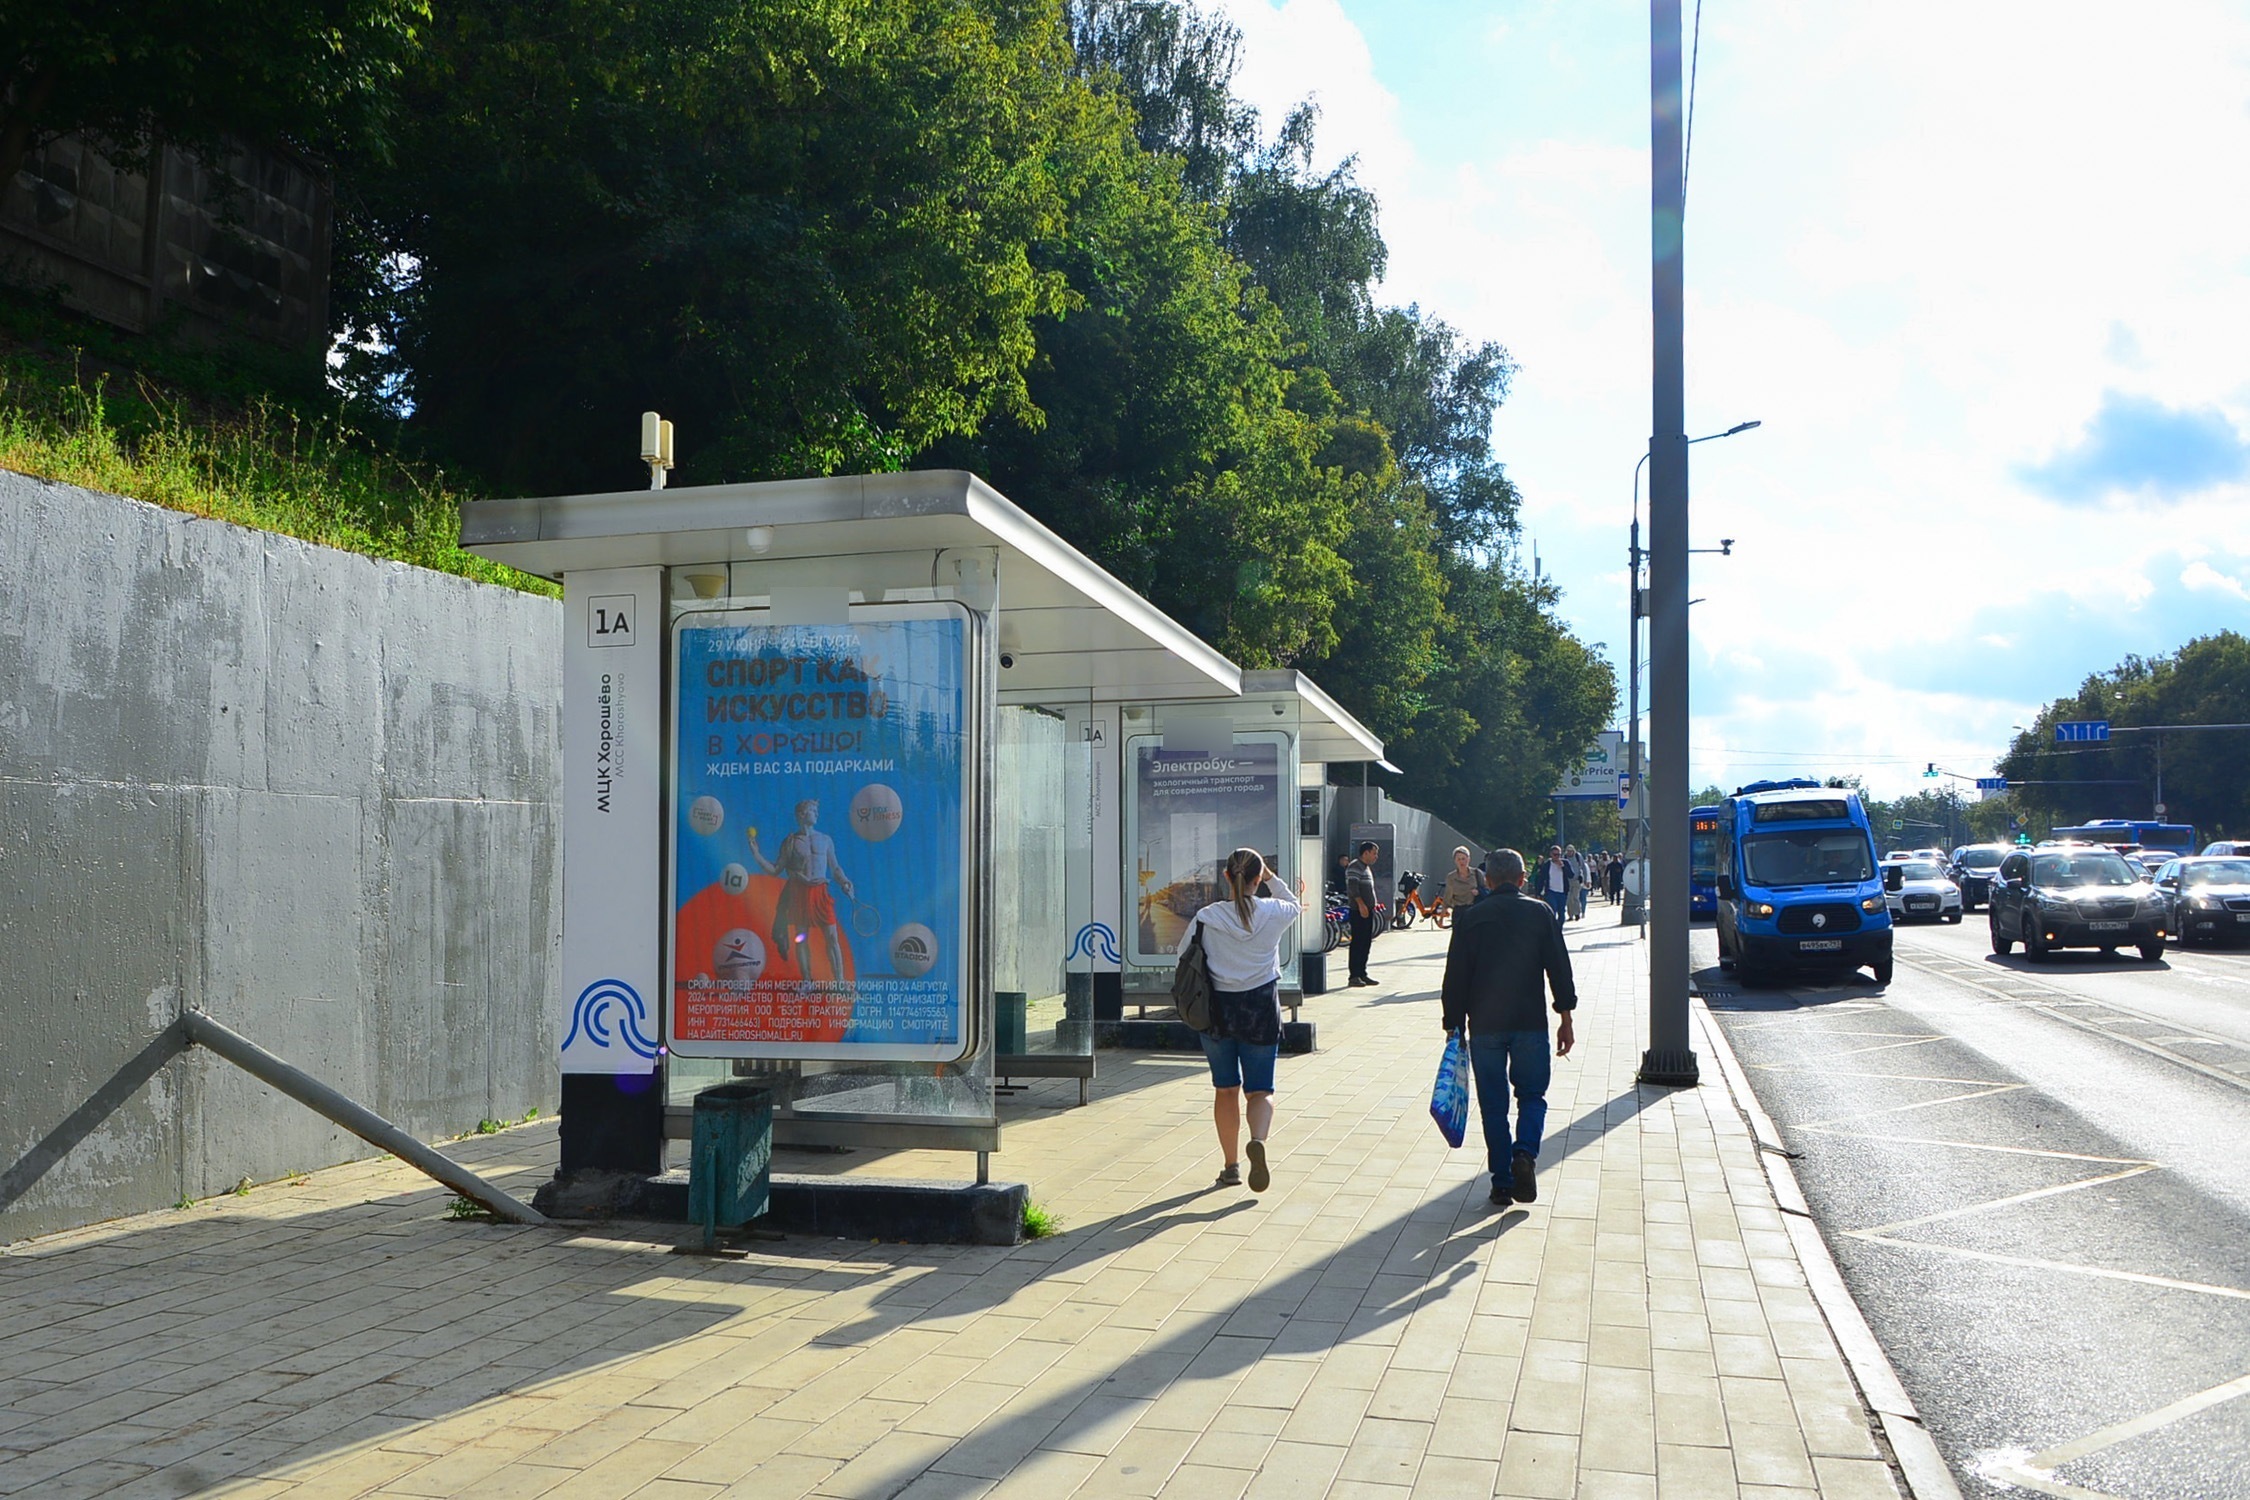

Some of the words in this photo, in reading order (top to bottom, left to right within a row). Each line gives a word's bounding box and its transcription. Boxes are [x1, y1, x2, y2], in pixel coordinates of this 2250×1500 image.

[707, 639, 723, 653] 29
[706, 656, 809, 688] СПОРТ
[614, 672, 628, 749] Khoroshyovo
[706, 689, 888, 724] ИСКУССТВО
[597, 673, 614, 764] Хорошёво
[707, 735, 723, 757] В
[706, 763, 750, 778] ЖДЕМ
[753, 761, 780, 775] ВАС
[784, 761, 801, 774] ЗА
[805, 759, 894, 775] ПОДАРКАМИ
[1152, 757, 1235, 774] Электробус
[1574, 766, 1615, 776] arPrice
[1153, 777, 1209, 787] экологичный
[1210, 775, 1255, 786] транспорт
[597, 766, 613, 814] МЦК
[1153, 788, 1169, 797] для
[1170, 785, 1233, 797] современного
[1234, 783, 1265, 794] города
[894, 951, 931, 963] STADION
[687, 980, 715, 990] СРОКИ
[717, 980, 773, 991] ПРОВЕДЕНИЯ
[774, 980, 837, 991] МЕРОПРИЯТИЯ
[858, 981, 884, 992] ИЮНЯ
[886, 981, 898, 991] ПО
[899, 981, 909, 992] 24
[911, 981, 949, 992] АВГУСТА
[687, 992, 706, 1002] 2024
[719, 992, 773, 1003] КОЛИЧЕСТВО
[777, 992, 822, 1003] ПОДАРКОВ
[887, 993, 949, 1004] ОРГАНИЗАТОР
[687, 1004, 749, 1015] МЕРОПРИЯТИЯ
[755, 1005, 772, 1015] ООО
[687, 1017, 706, 1027] ИНН
[768, 1018, 821, 1030] ПОДРОБНУЮ
[828, 1019, 894, 1031] ИНФОРМАЦИЮ
[901, 1019, 949, 1030] СМОТРИТЕ
[687, 1030, 699, 1039] НА
[700, 1028, 727, 1040] САЙТЕ
